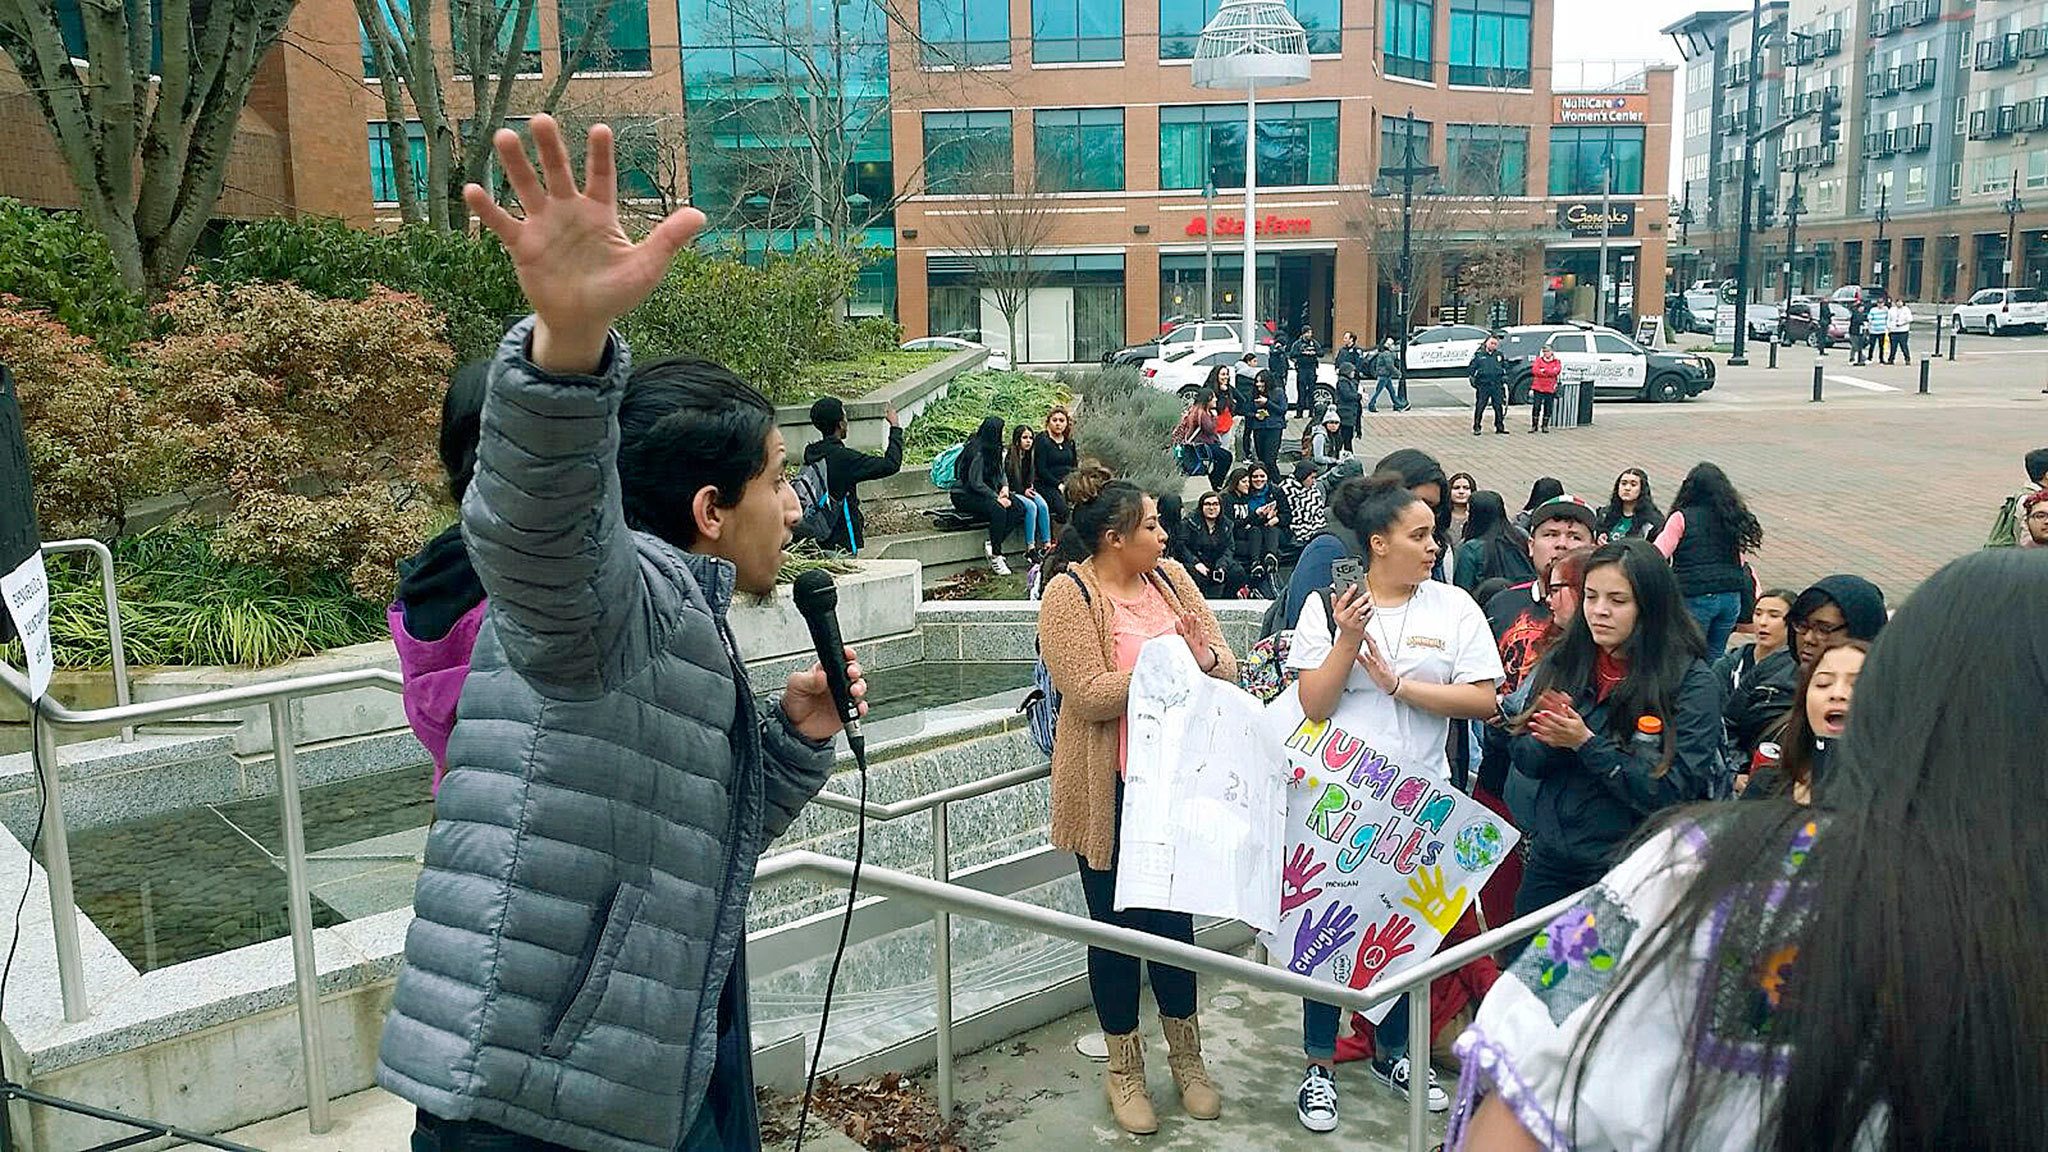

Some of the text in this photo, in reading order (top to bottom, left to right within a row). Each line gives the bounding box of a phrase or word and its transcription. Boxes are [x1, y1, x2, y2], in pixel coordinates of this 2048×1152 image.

[1562, 98, 1612, 109] MultiCare
[1561, 110, 1643, 122] Women's Center
[1215, 215, 1311, 235] Stae Farm
[1420, 349, 1468, 359] POLICE
[1305, 782, 1444, 874] Rights
